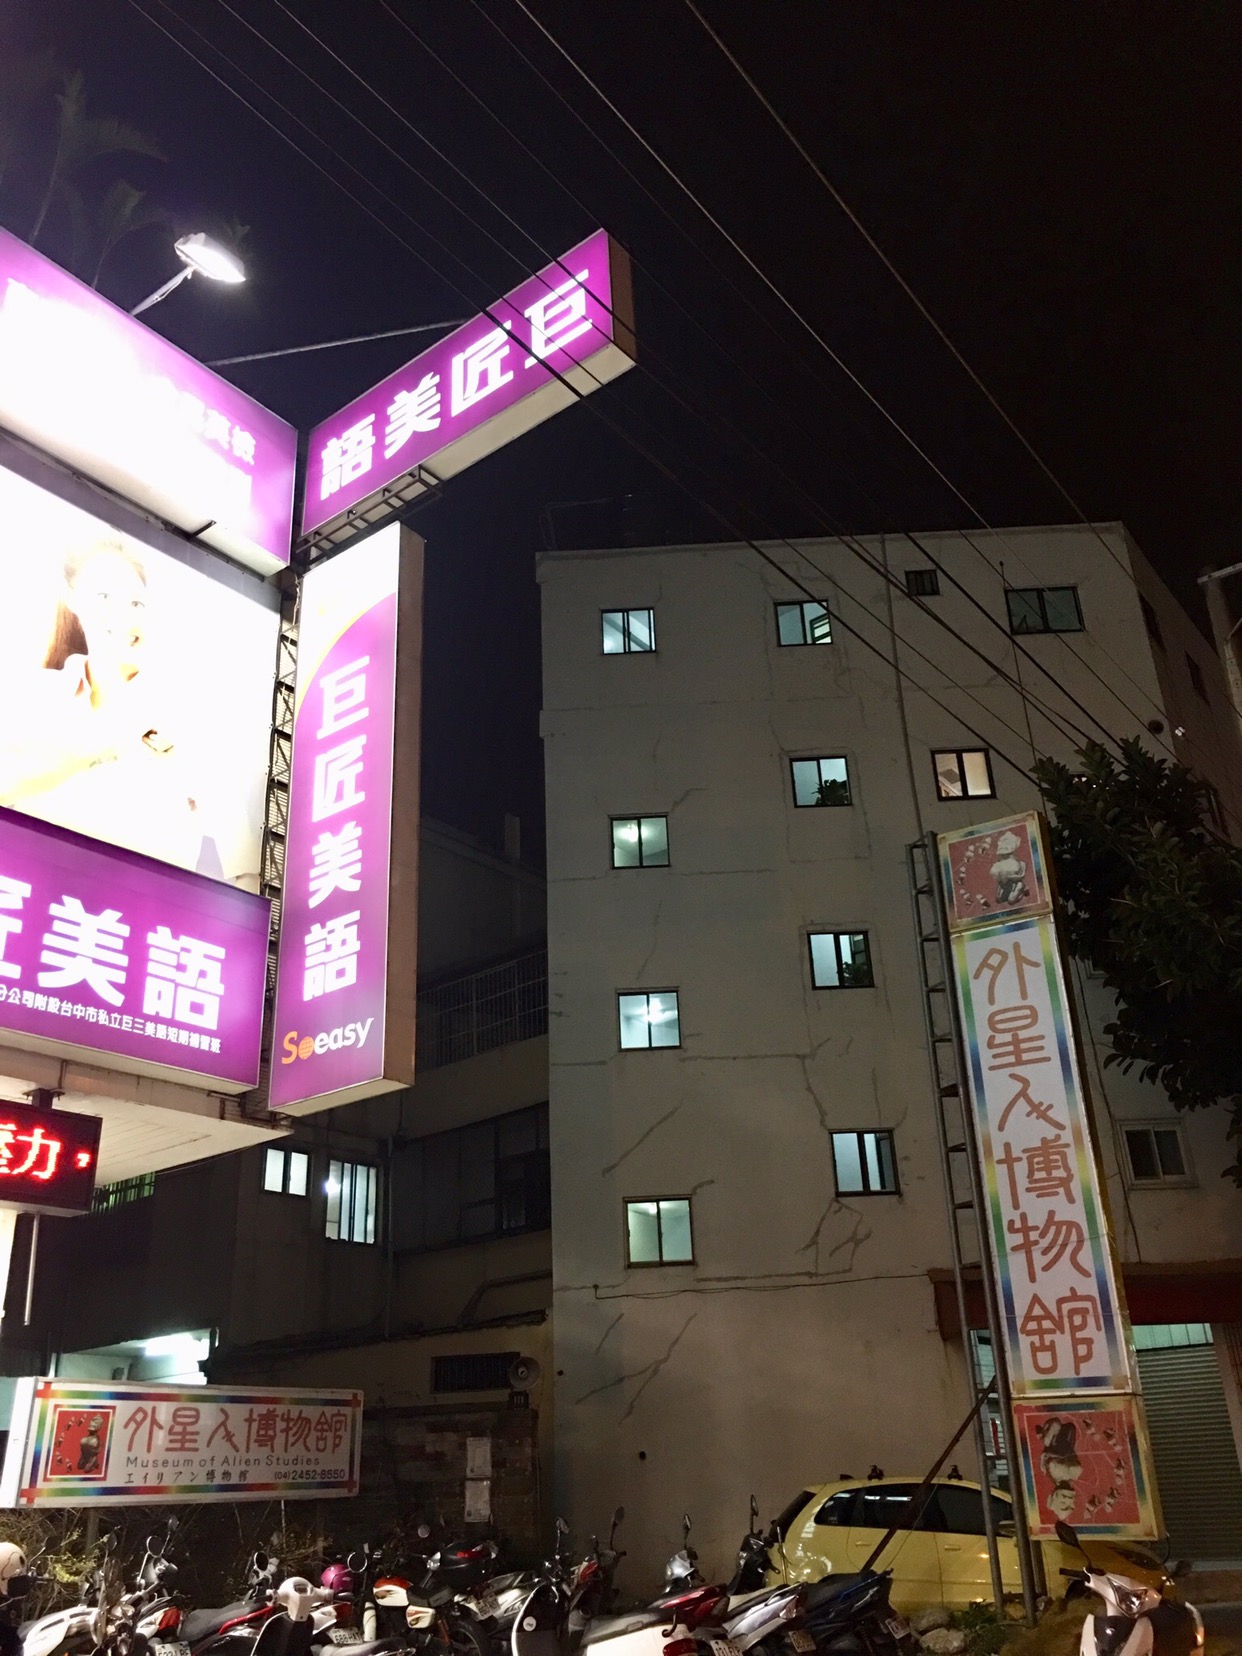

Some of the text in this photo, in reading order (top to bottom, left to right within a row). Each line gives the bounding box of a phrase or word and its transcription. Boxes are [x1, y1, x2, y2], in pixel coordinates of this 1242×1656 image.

[303, 654, 371, 1002] 巨匠美語
[126, 1455, 321, 1468] Museum of Alien Studies
